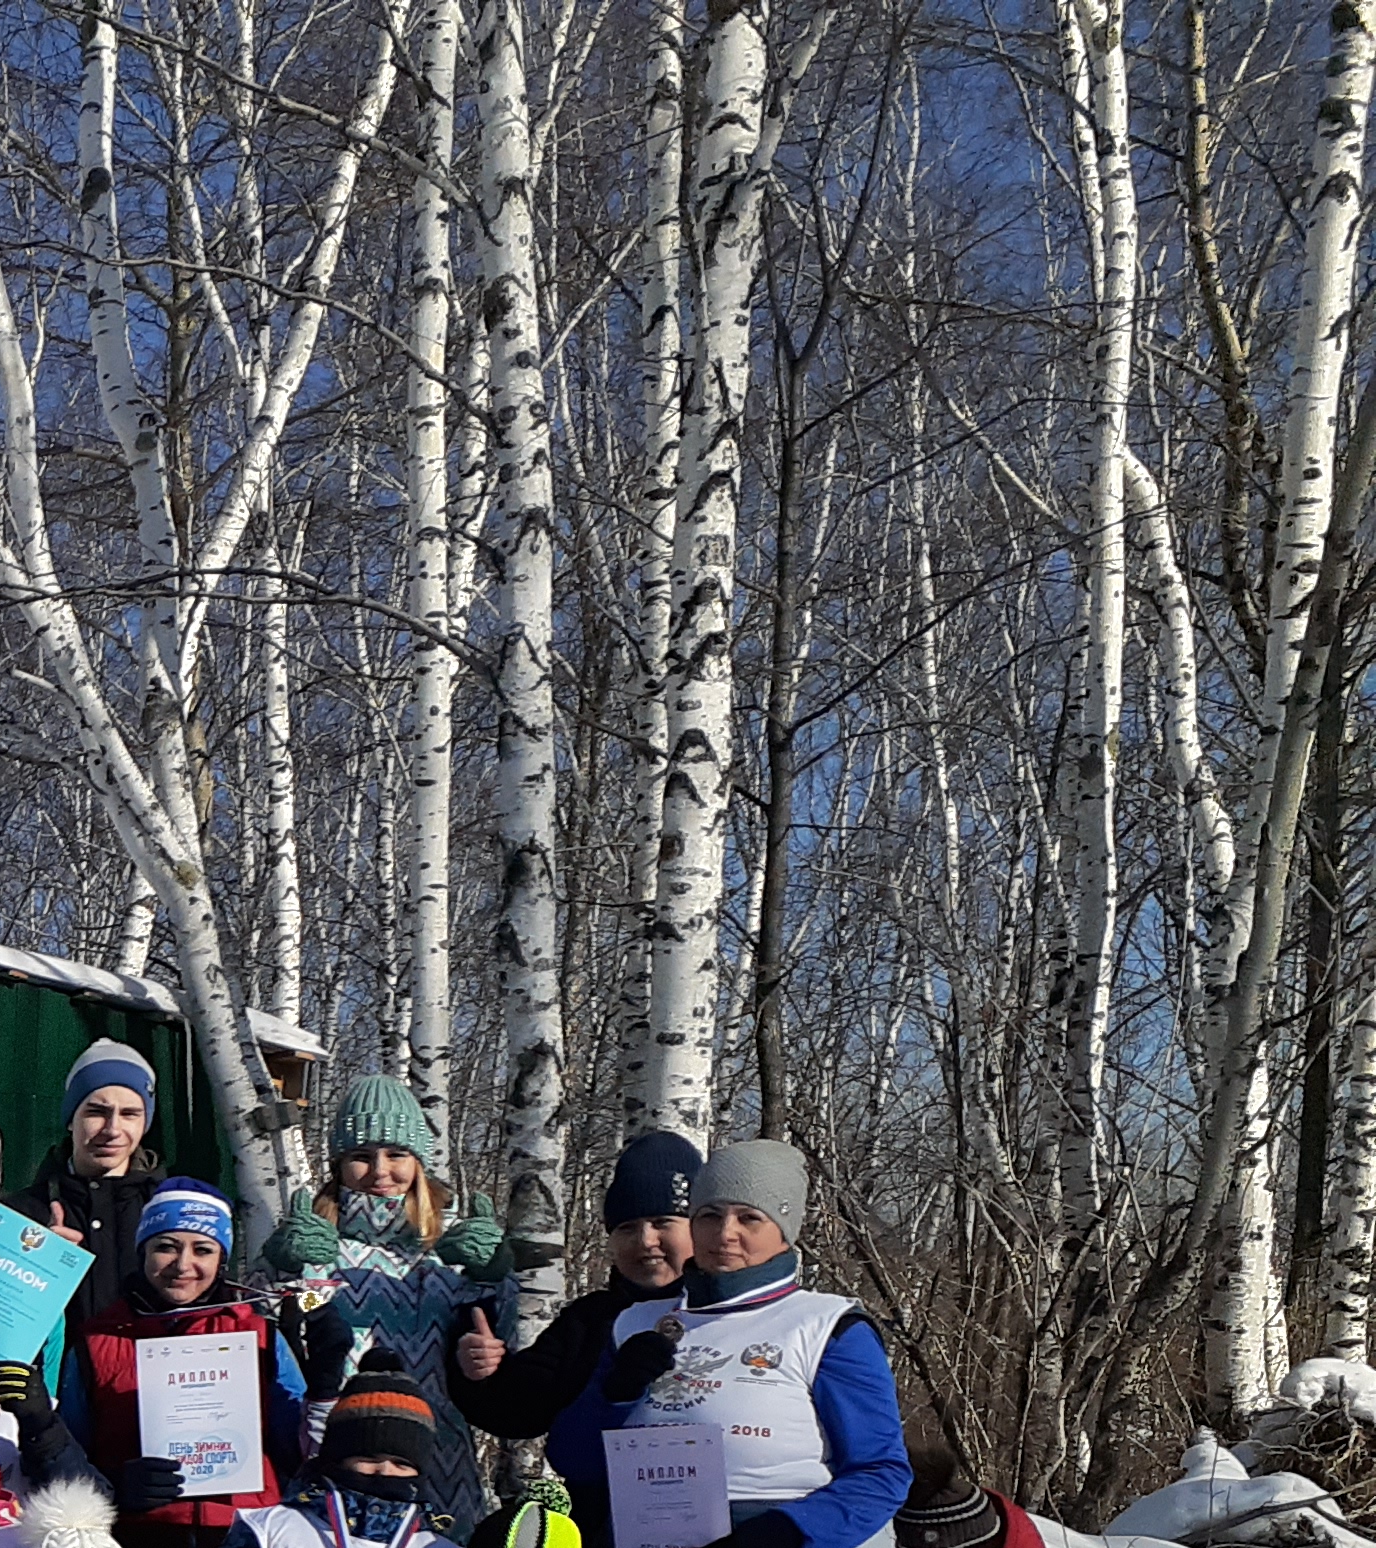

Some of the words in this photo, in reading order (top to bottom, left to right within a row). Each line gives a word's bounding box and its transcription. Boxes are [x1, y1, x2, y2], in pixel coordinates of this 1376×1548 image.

[168, 1370, 229, 1386] ДИПЛОМ
[689, 1380, 722, 1388] 2018
[645, 1395, 707, 1412] РОССИИ
[730, 1424, 771, 1438] 2018
[168, 1442, 194, 1456] ДЕНЬ
[195, 1441, 233, 1453] ЗИМНИХ
[205, 1451, 239, 1464] СПОРТА
[191, 1465, 214, 1475] 2020
[637, 1466, 697, 1481] ДИПЛОМ
